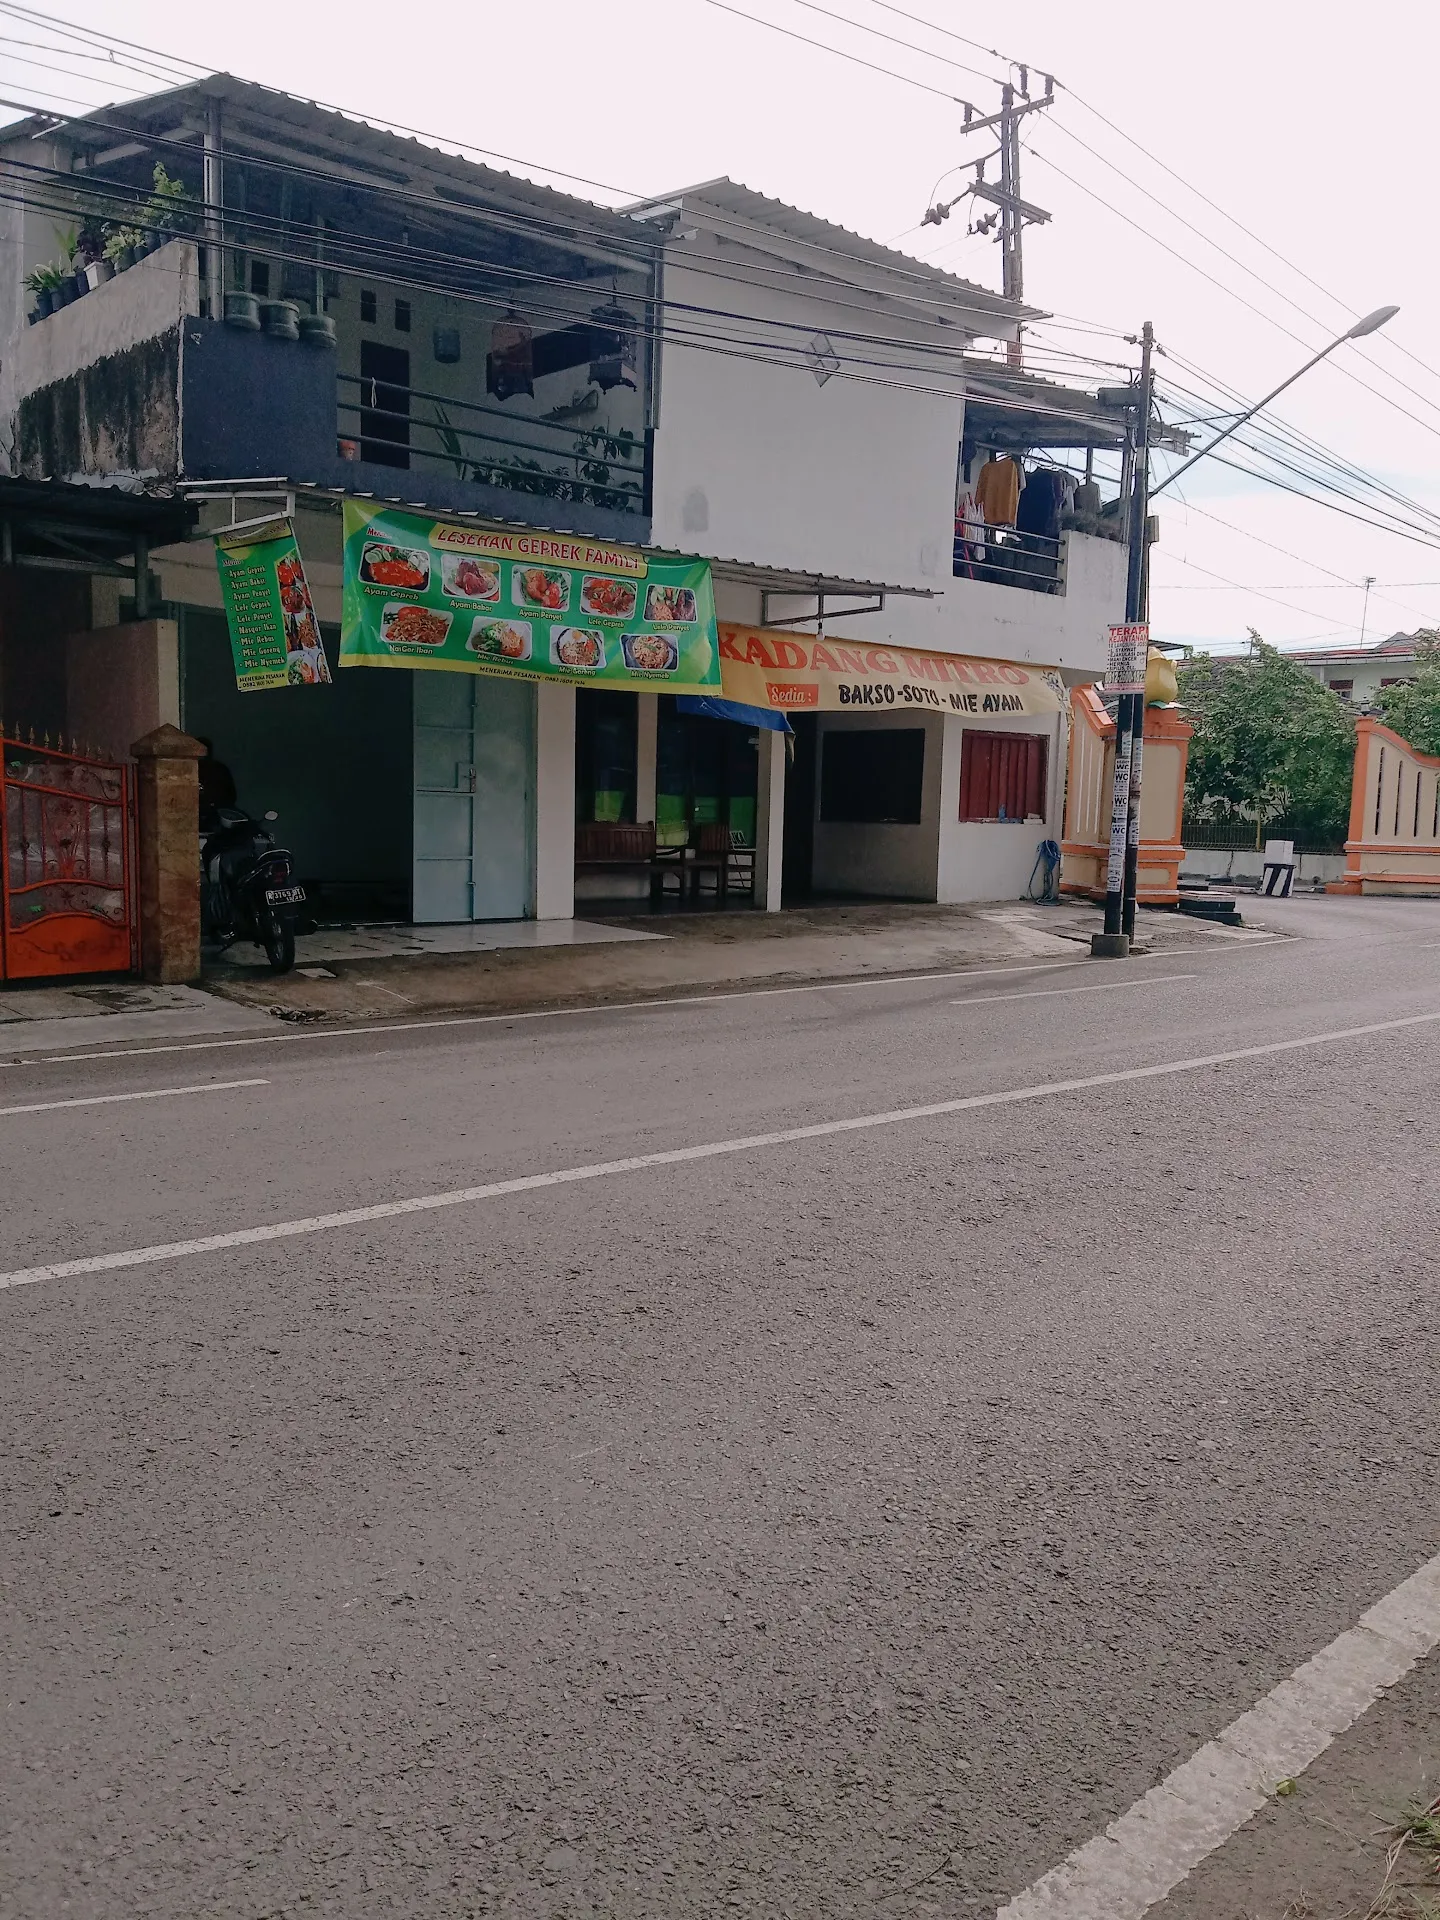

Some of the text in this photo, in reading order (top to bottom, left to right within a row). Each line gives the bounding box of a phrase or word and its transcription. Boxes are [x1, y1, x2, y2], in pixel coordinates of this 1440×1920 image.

[437, 528, 513, 551] LESEHAN
[518, 537, 581, 561] GEPREK
[364, 586, 388, 597] Ayam
[450, 600, 471, 609] Ayam
[519, 609, 539, 618] Ayam
[1109, 626, 1149, 636] TERAPI
[718, 632, 1030, 686] KADANG MITRO
[479, 666, 512, 676] MENERIMA
[949, 693, 978, 712] MIE
[982, 693, 1024, 713] AYAM
[1116, 773, 1129, 781] WC
[1114, 797, 1128, 805] WC
